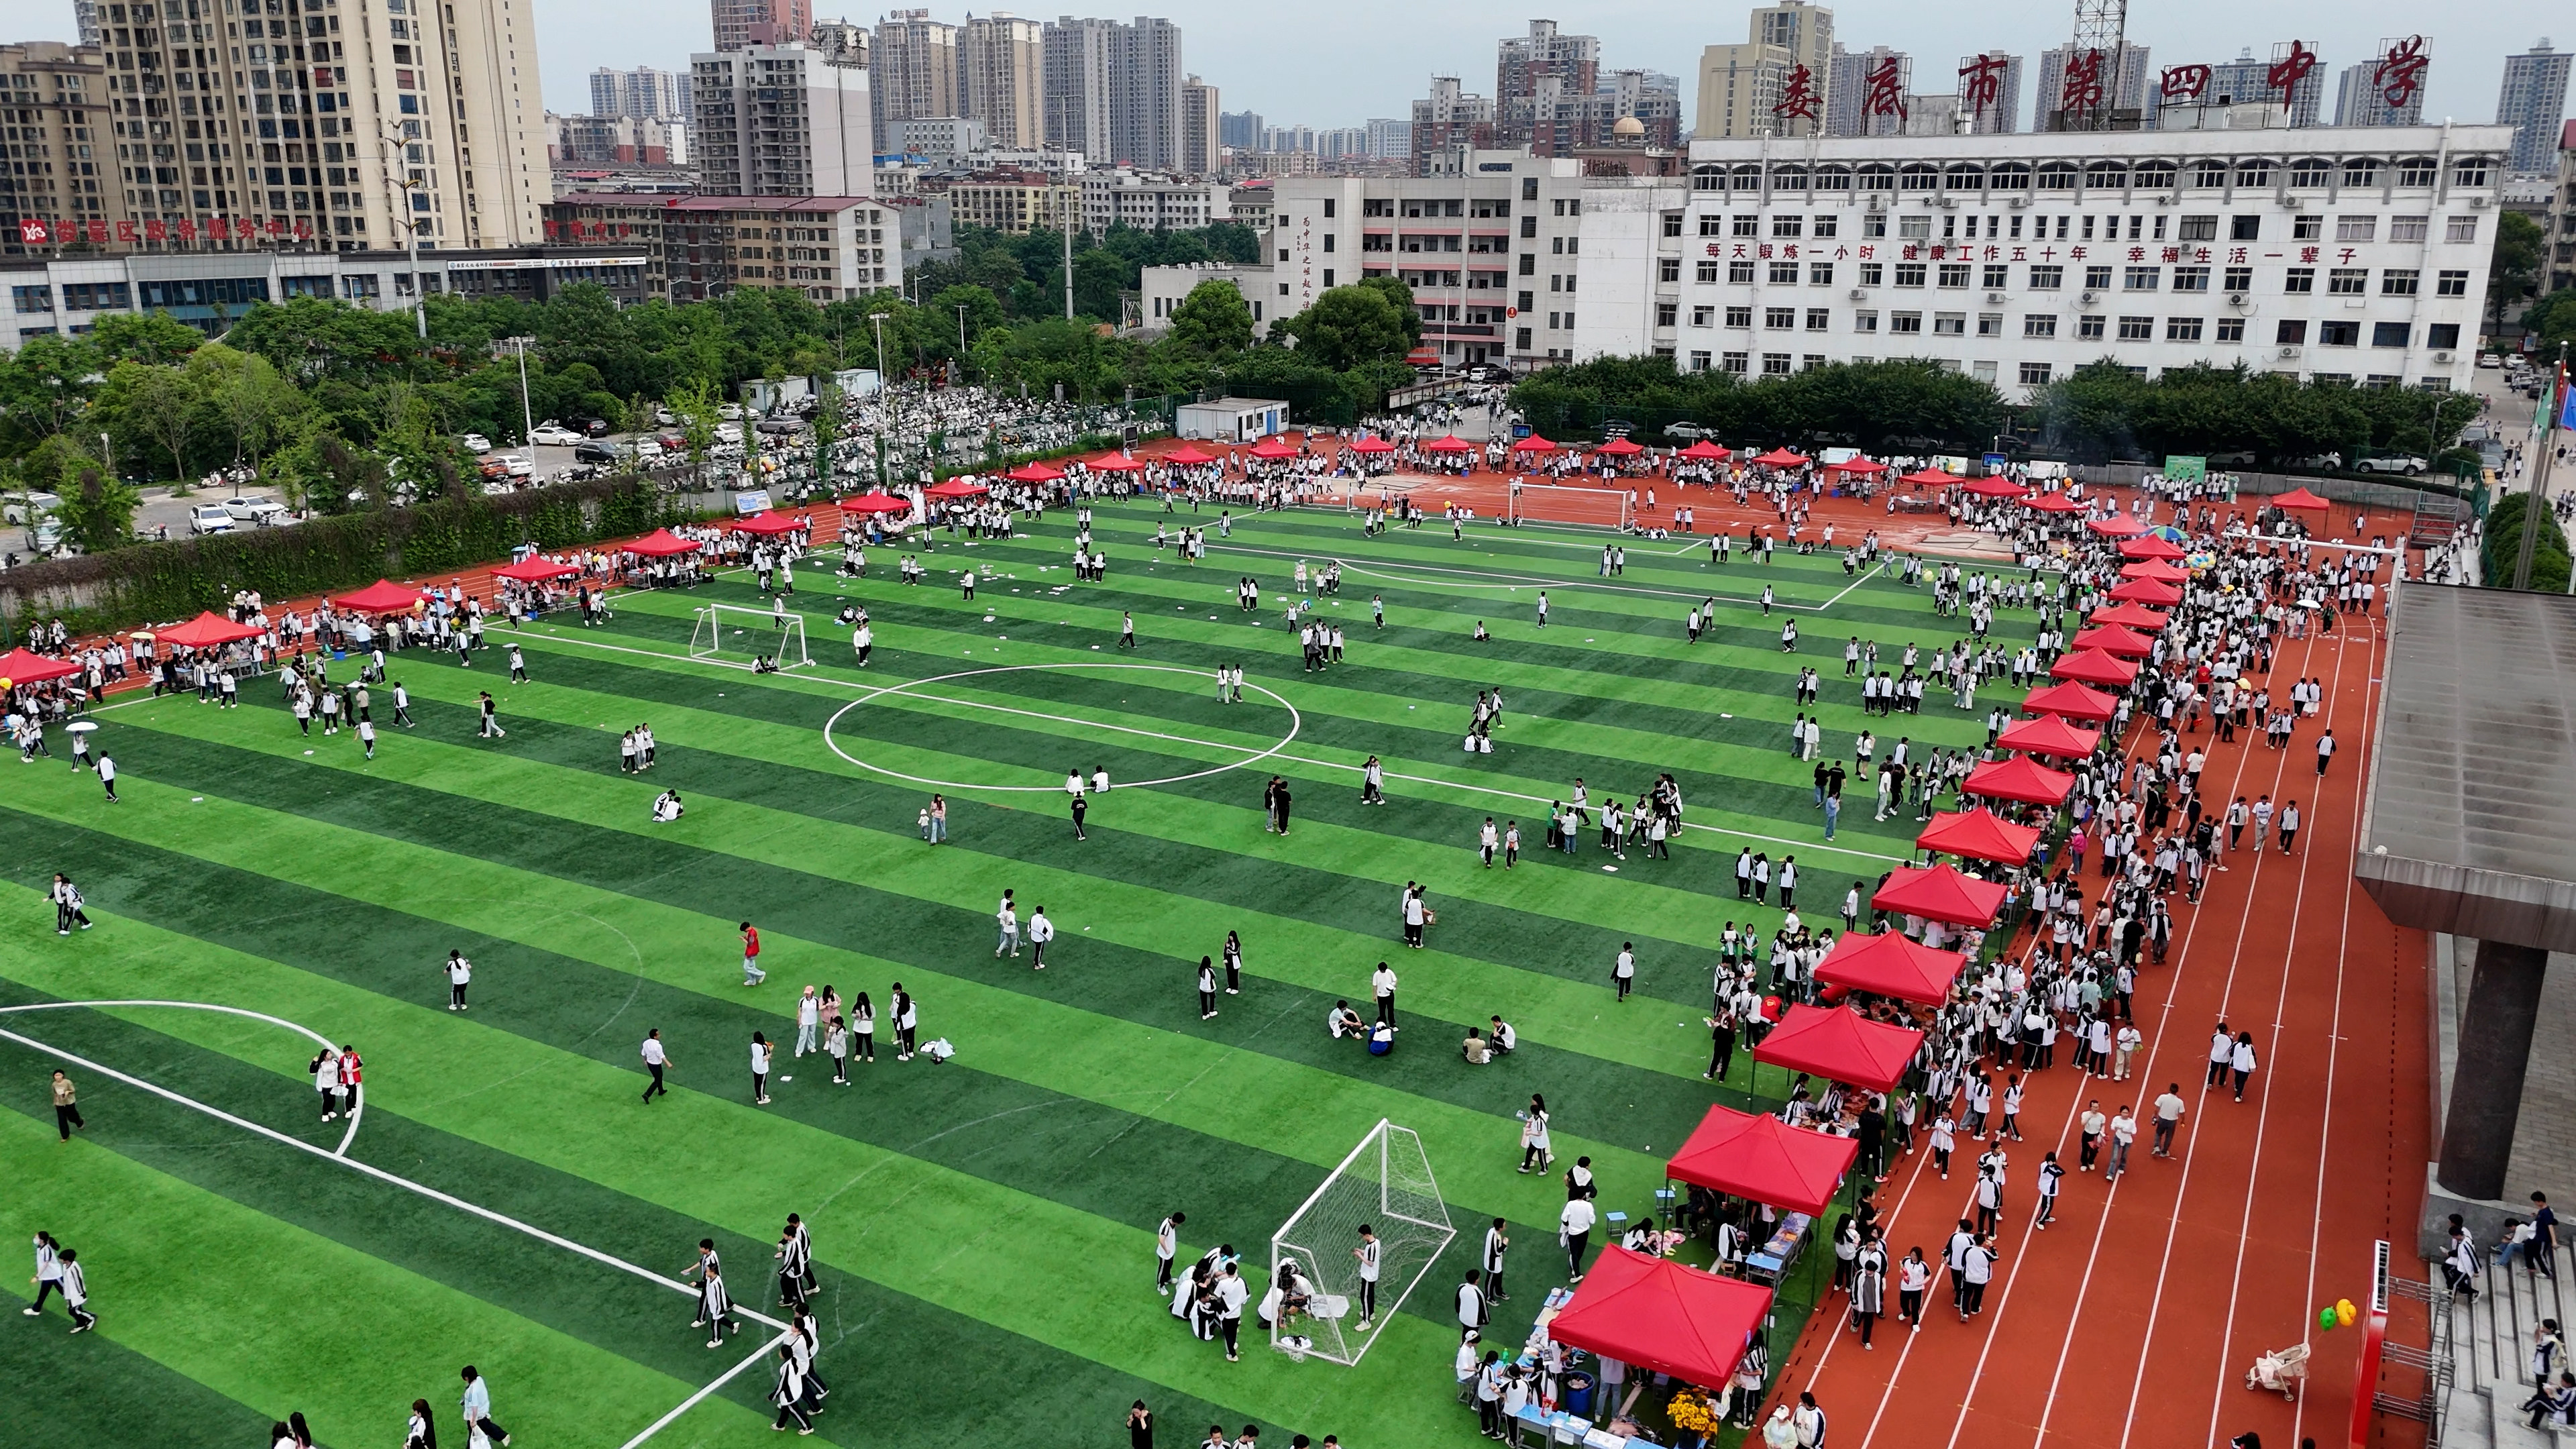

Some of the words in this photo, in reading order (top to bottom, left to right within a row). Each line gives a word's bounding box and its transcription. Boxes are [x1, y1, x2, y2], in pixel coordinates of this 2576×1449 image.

[1773, 34, 2430, 121] 娄底市第四中学
[55, 218, 313, 243] 娄星区政务服务中心
[1705, 242, 1875, 260] 每天锻炼一小时
[1902, 244, 2088, 262] 健康工作五十年
[2127, 246, 2357, 265] 幸福生活一辈子
